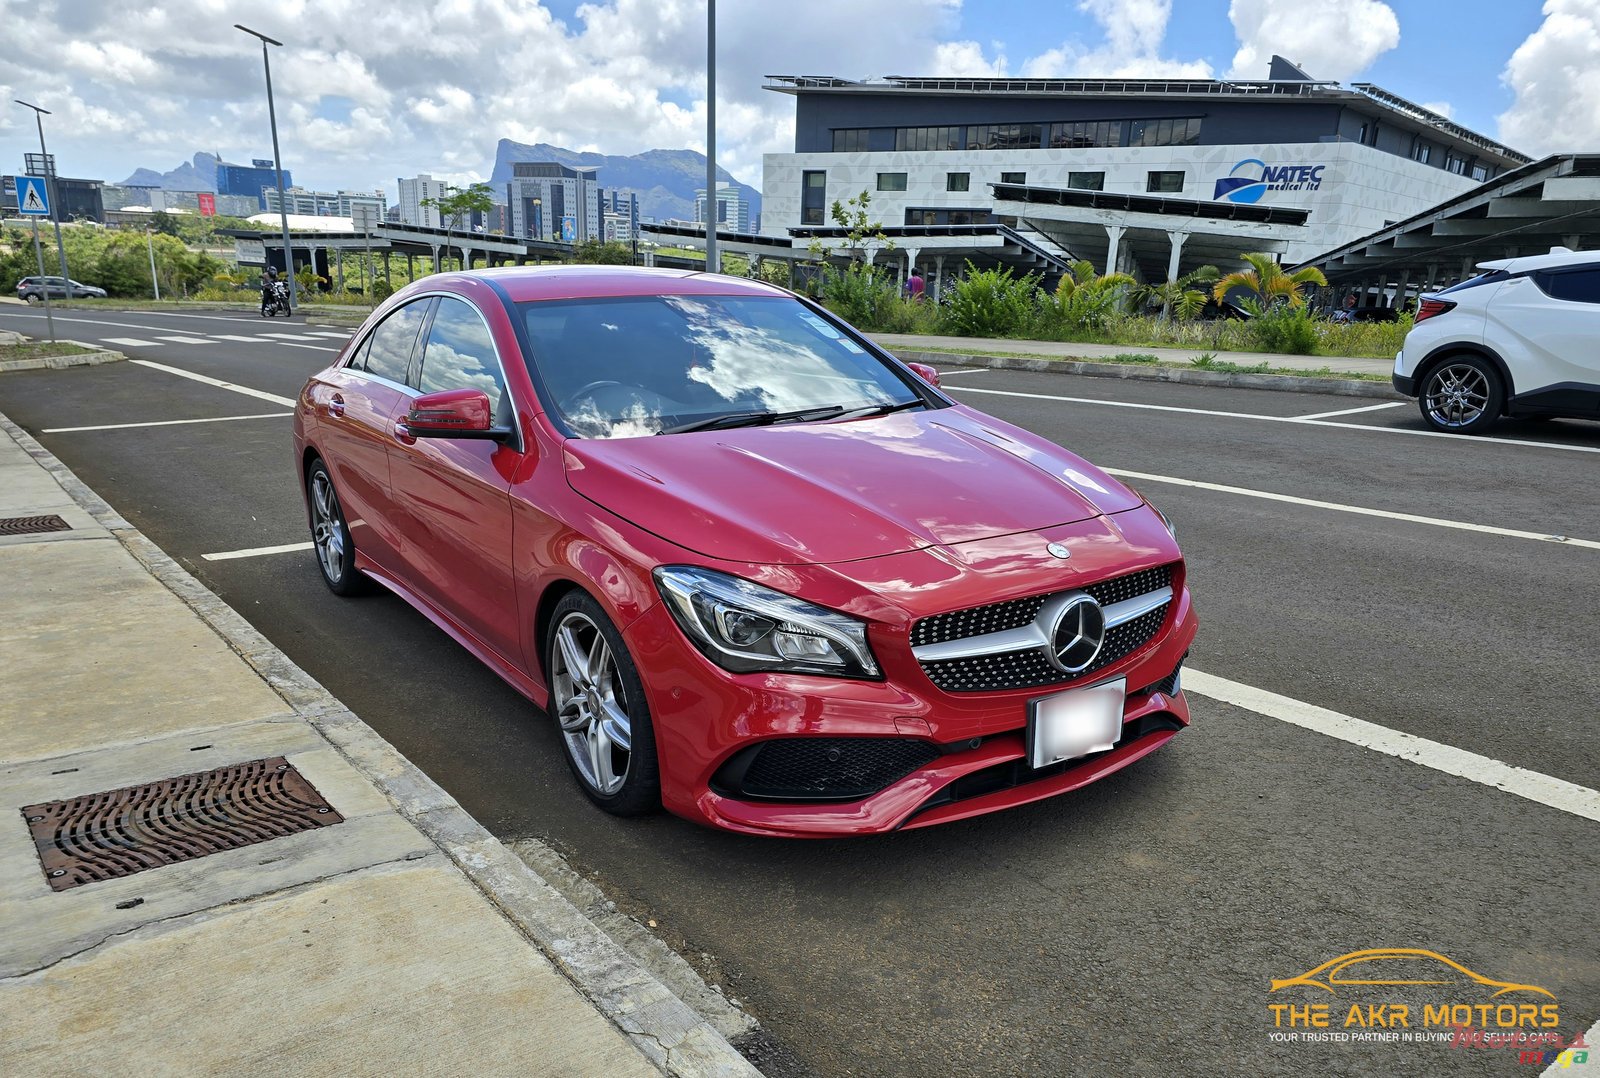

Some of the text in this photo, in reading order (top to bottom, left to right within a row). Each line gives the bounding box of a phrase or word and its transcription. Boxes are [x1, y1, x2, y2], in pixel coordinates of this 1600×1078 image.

[1260, 166, 1325, 182] NATEC
[1267, 182, 1320, 191] medical ltd
